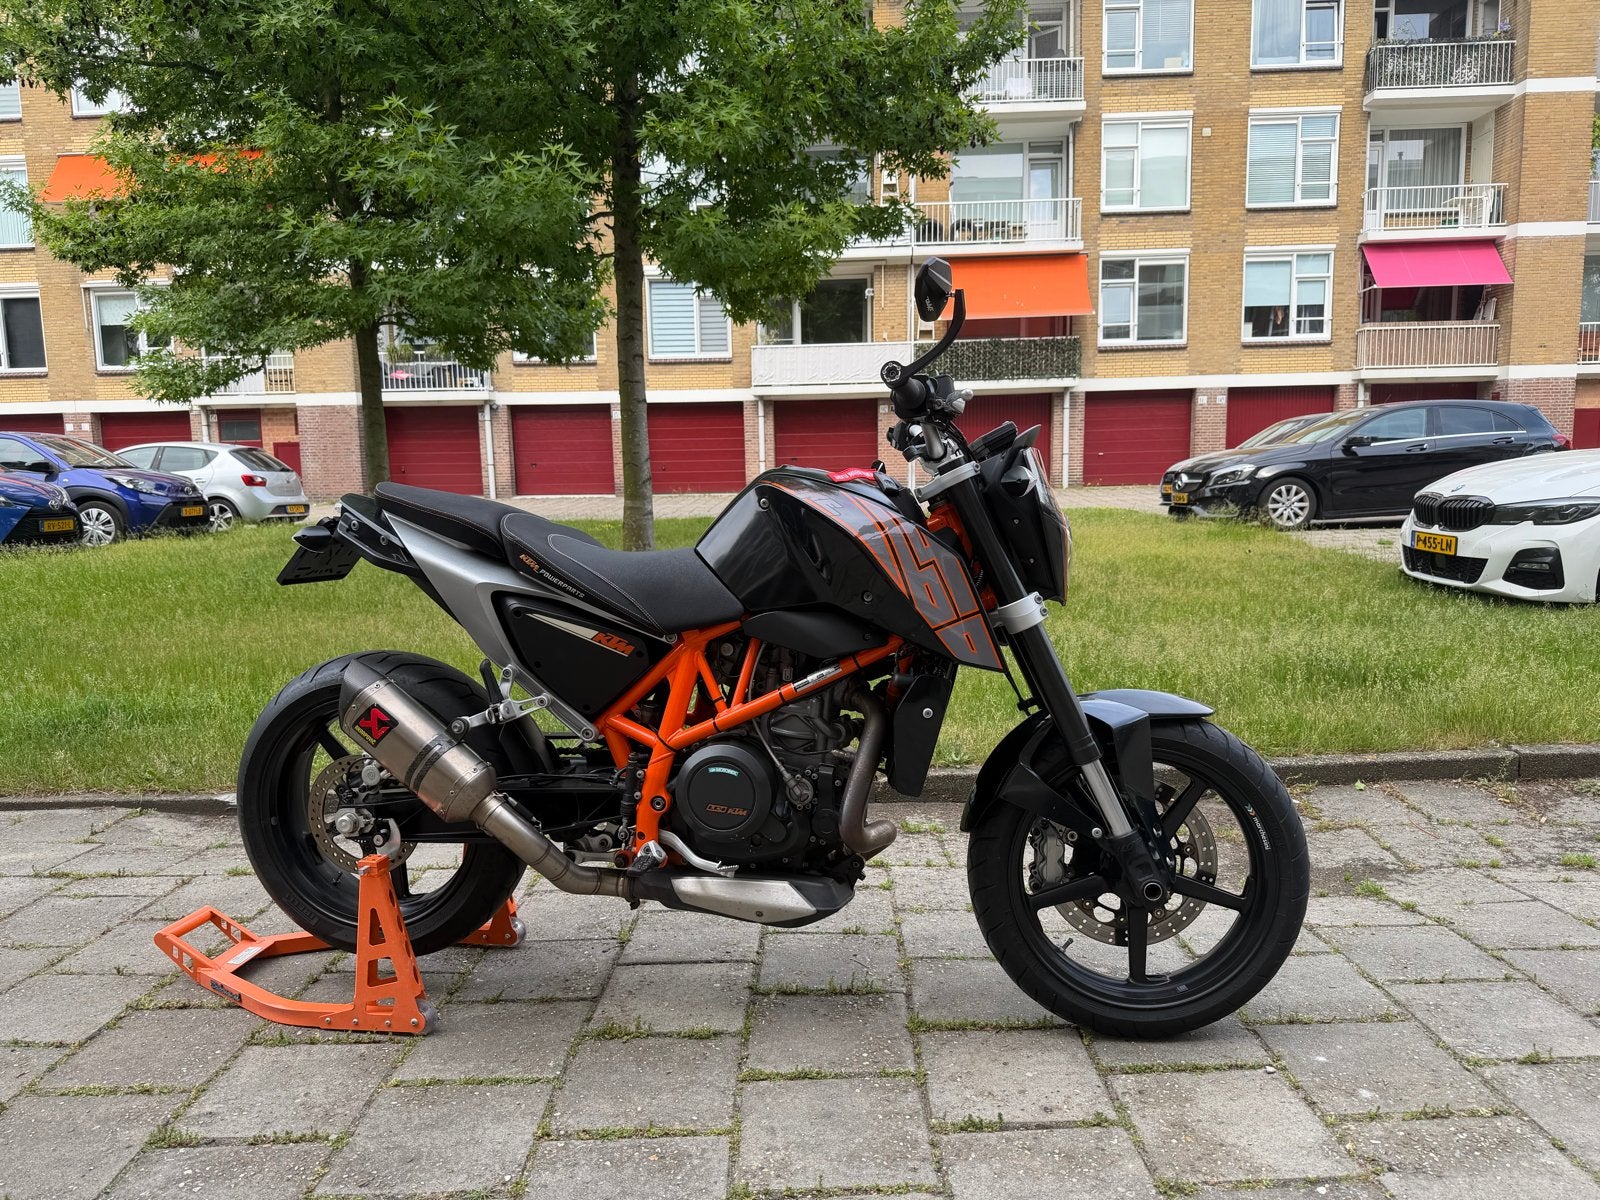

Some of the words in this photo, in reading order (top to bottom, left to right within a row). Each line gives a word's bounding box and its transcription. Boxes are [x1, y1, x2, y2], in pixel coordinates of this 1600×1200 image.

[1416, 534, 1453, 552] P-455-LN
[519, 554, 540, 573] KTM
[539, 568, 586, 598] POWERPARTS
[592, 632, 636, 655] KTM
[1252, 816, 1272, 851] marchesini
